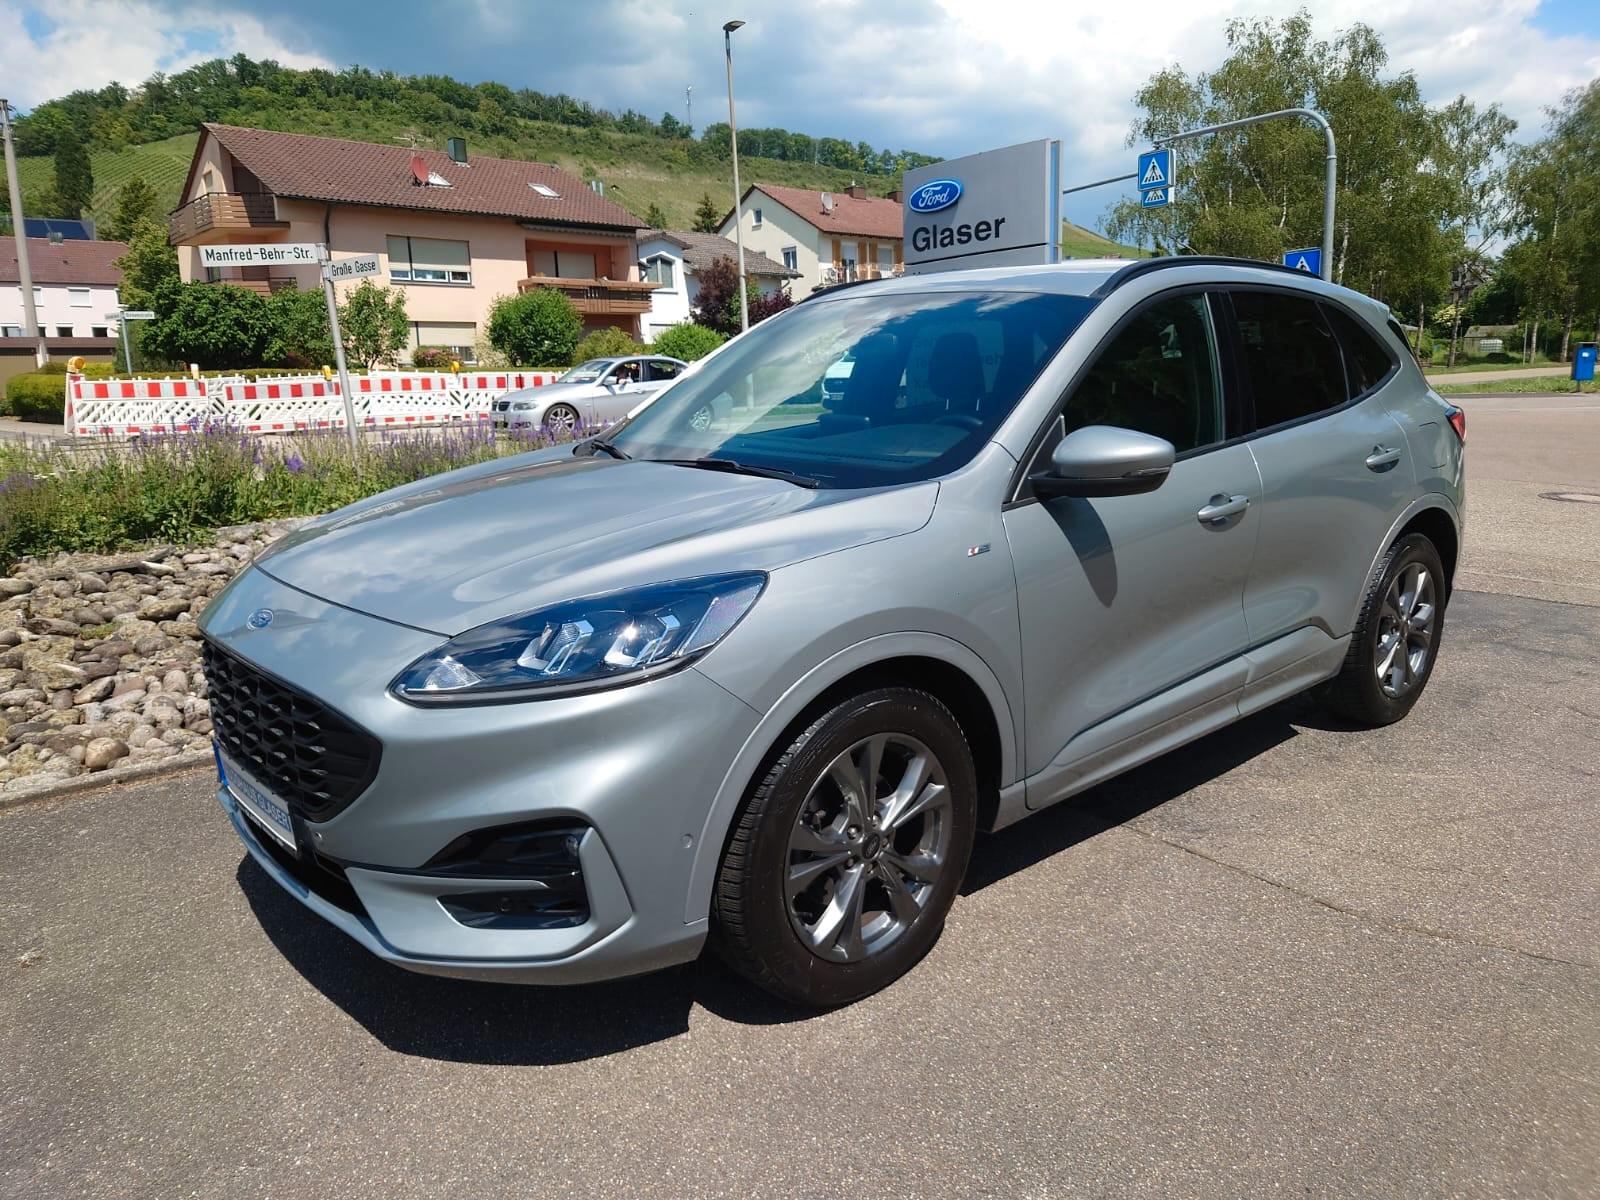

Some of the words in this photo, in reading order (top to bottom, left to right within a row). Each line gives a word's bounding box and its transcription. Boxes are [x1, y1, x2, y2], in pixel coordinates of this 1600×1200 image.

[918, 185, 950, 208] Ford
[912, 216, 1006, 252] Glaser
[205, 246, 313, 262] Manfred-Behr-Str.
[331, 260, 352, 277] Große
[355, 259, 376, 273] Gasse
